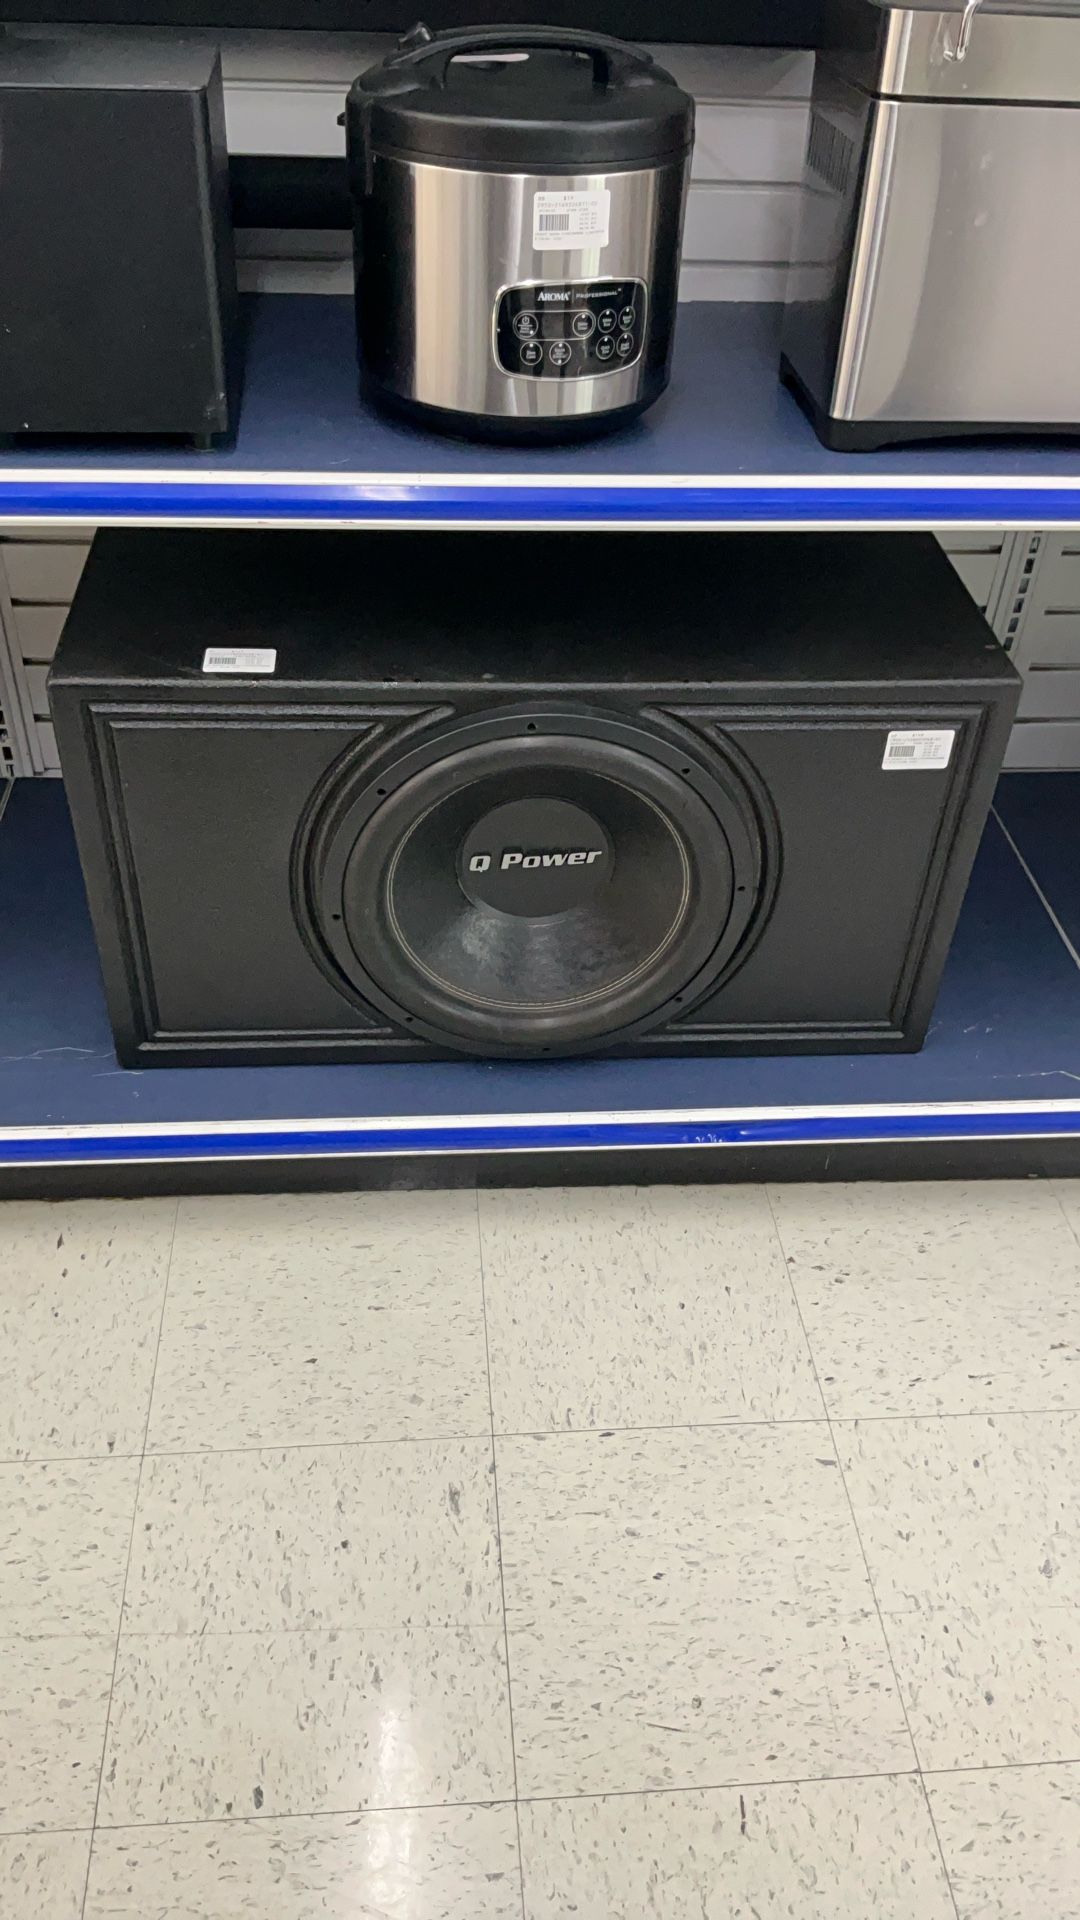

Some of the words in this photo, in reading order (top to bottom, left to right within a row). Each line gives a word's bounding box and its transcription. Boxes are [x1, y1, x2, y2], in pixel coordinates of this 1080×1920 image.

[537, 291, 569, 302] AROMA
[469, 855, 491, 873] Q
[500, 850, 602, 870] Power
